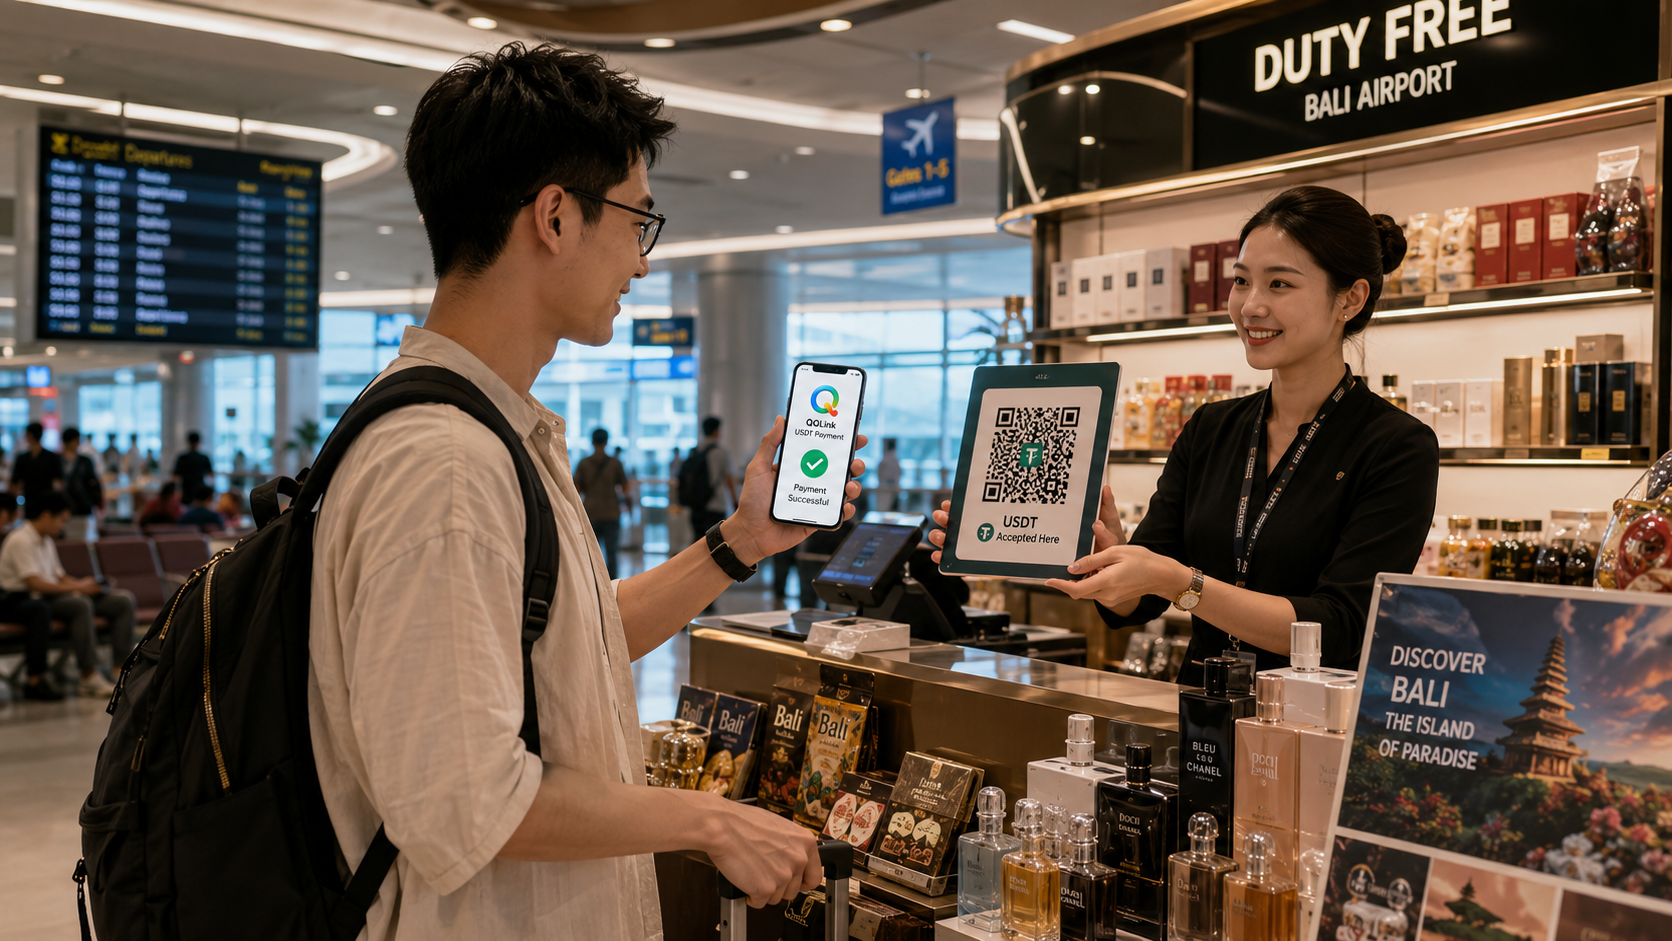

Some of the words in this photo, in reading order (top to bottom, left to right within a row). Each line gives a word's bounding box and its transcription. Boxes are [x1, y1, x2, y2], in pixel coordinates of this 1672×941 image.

[1255, 16, 1371, 92] DUTY
[1385, 0, 1512, 60] FREE
[1305, 85, 1351, 122] BALI
[1356, 60, 1457, 111] AIRPORT
[794, 429, 813, 437] USDT
[814, 432, 844, 441] Payment
[787, 494, 829, 506] Successful
[793, 484, 827, 495] Payment
[1003, 515, 1038, 529] USDT
[996, 532, 1037, 544] Accepted
[1038, 534, 1060, 544] Here
[1390, 645, 1486, 675] DISCOVER
[1390, 675, 1450, 709] BALI
[718, 709, 746, 736] Bali
[773, 704, 804, 732] Bali
[817, 712, 849, 741] Bali
[1385, 711, 1415, 732] THE
[1416, 716, 1475, 741] ISLAND
[1192, 741, 1216, 754] BLEU
[1378, 738, 1400, 758] OF
[1401, 742, 1479, 771] PARADISE
[1186, 761, 1222, 777] CHANEL
